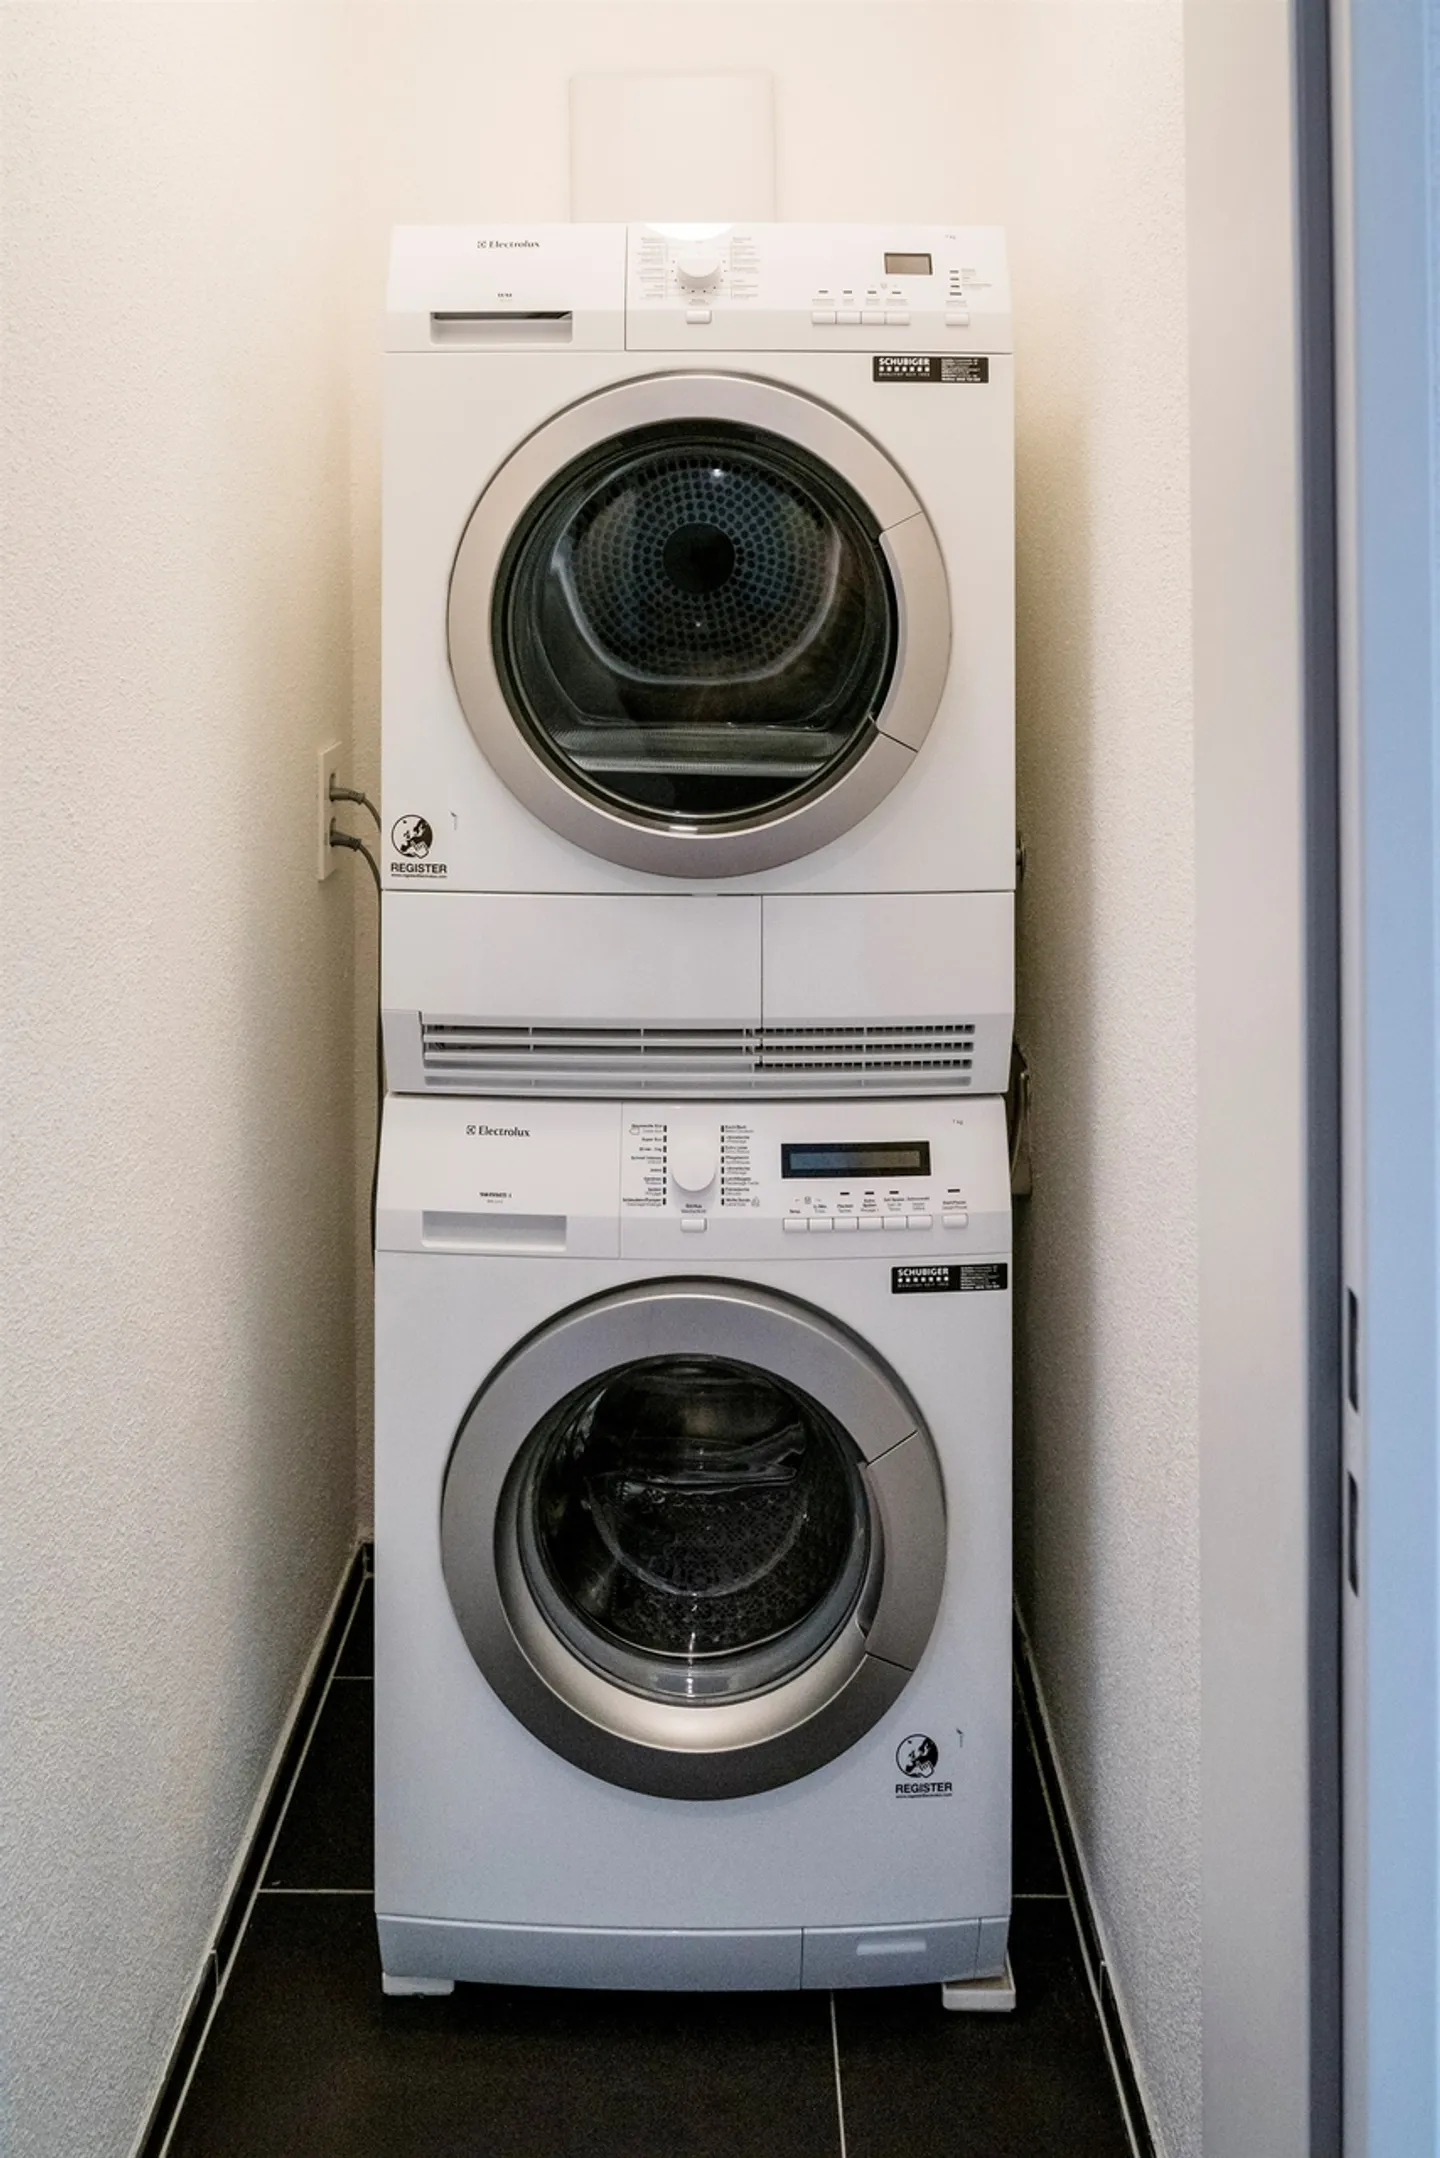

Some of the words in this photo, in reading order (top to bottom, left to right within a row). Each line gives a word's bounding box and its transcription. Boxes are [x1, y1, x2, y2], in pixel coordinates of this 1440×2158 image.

[488, 240, 540, 249] Electrolux
[878, 357, 931, 366] SCHUBIGER
[391, 863, 447, 874] REGISTER
[478, 1125, 531, 1138] Electrolux
[897, 1267, 949, 1277] SCHUBIGER
[895, 1782, 953, 1794] REGISTER
